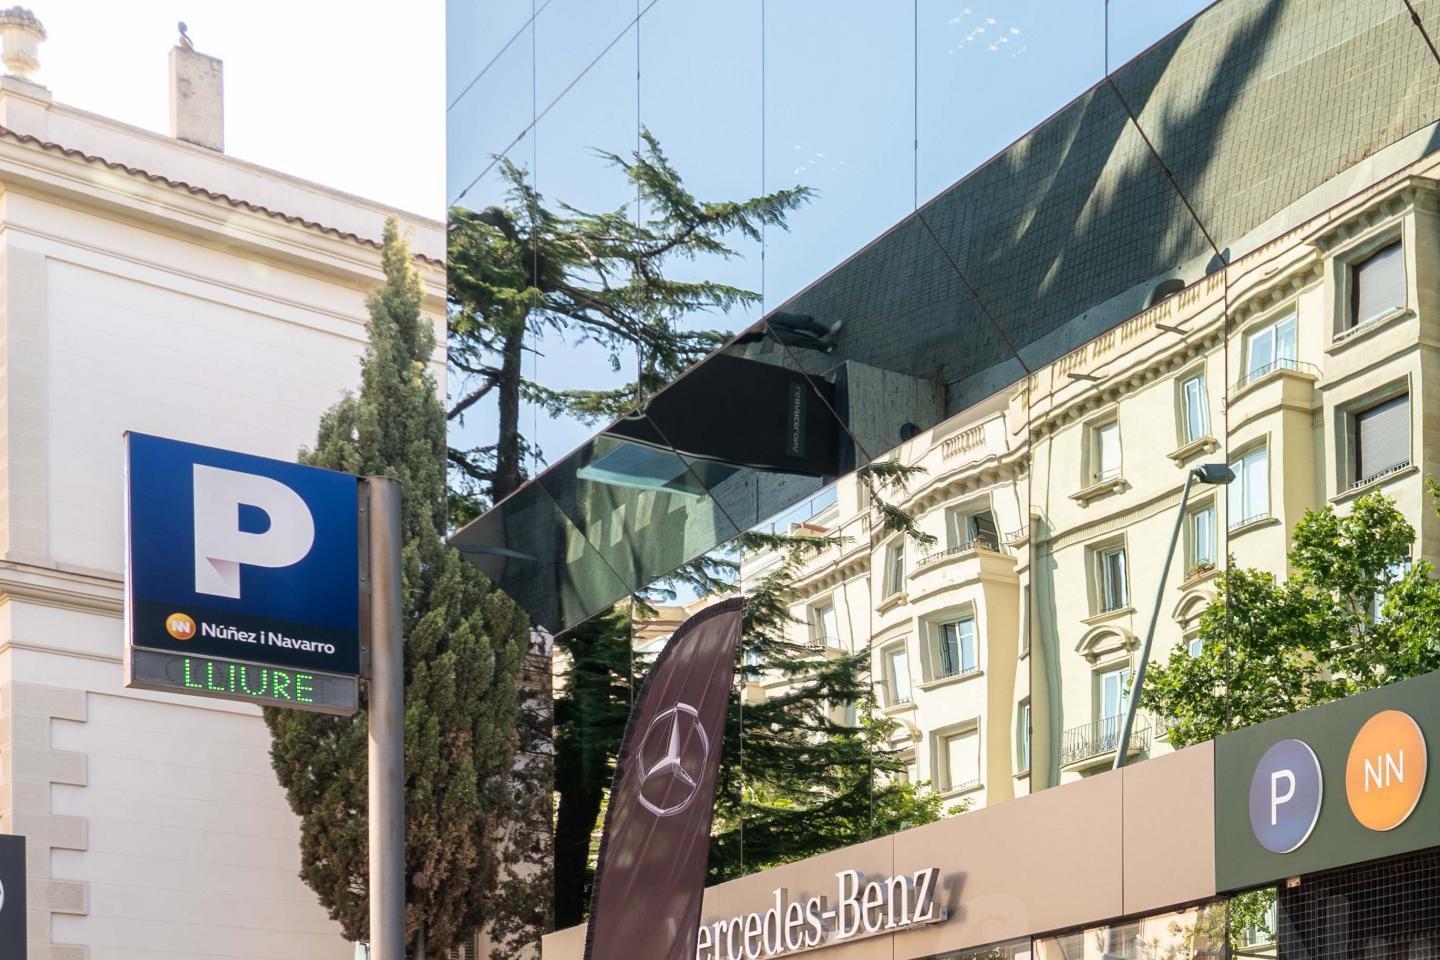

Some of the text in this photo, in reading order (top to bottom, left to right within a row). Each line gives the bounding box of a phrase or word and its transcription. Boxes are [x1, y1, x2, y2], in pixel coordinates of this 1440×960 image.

[193, 463, 315, 599] P
[201, 622, 336, 655] Núñez i Navarro
[183, 658, 313, 703] LLIURE
[1363, 749, 1404, 792] NN
[1271, 769, 1296, 826] P
